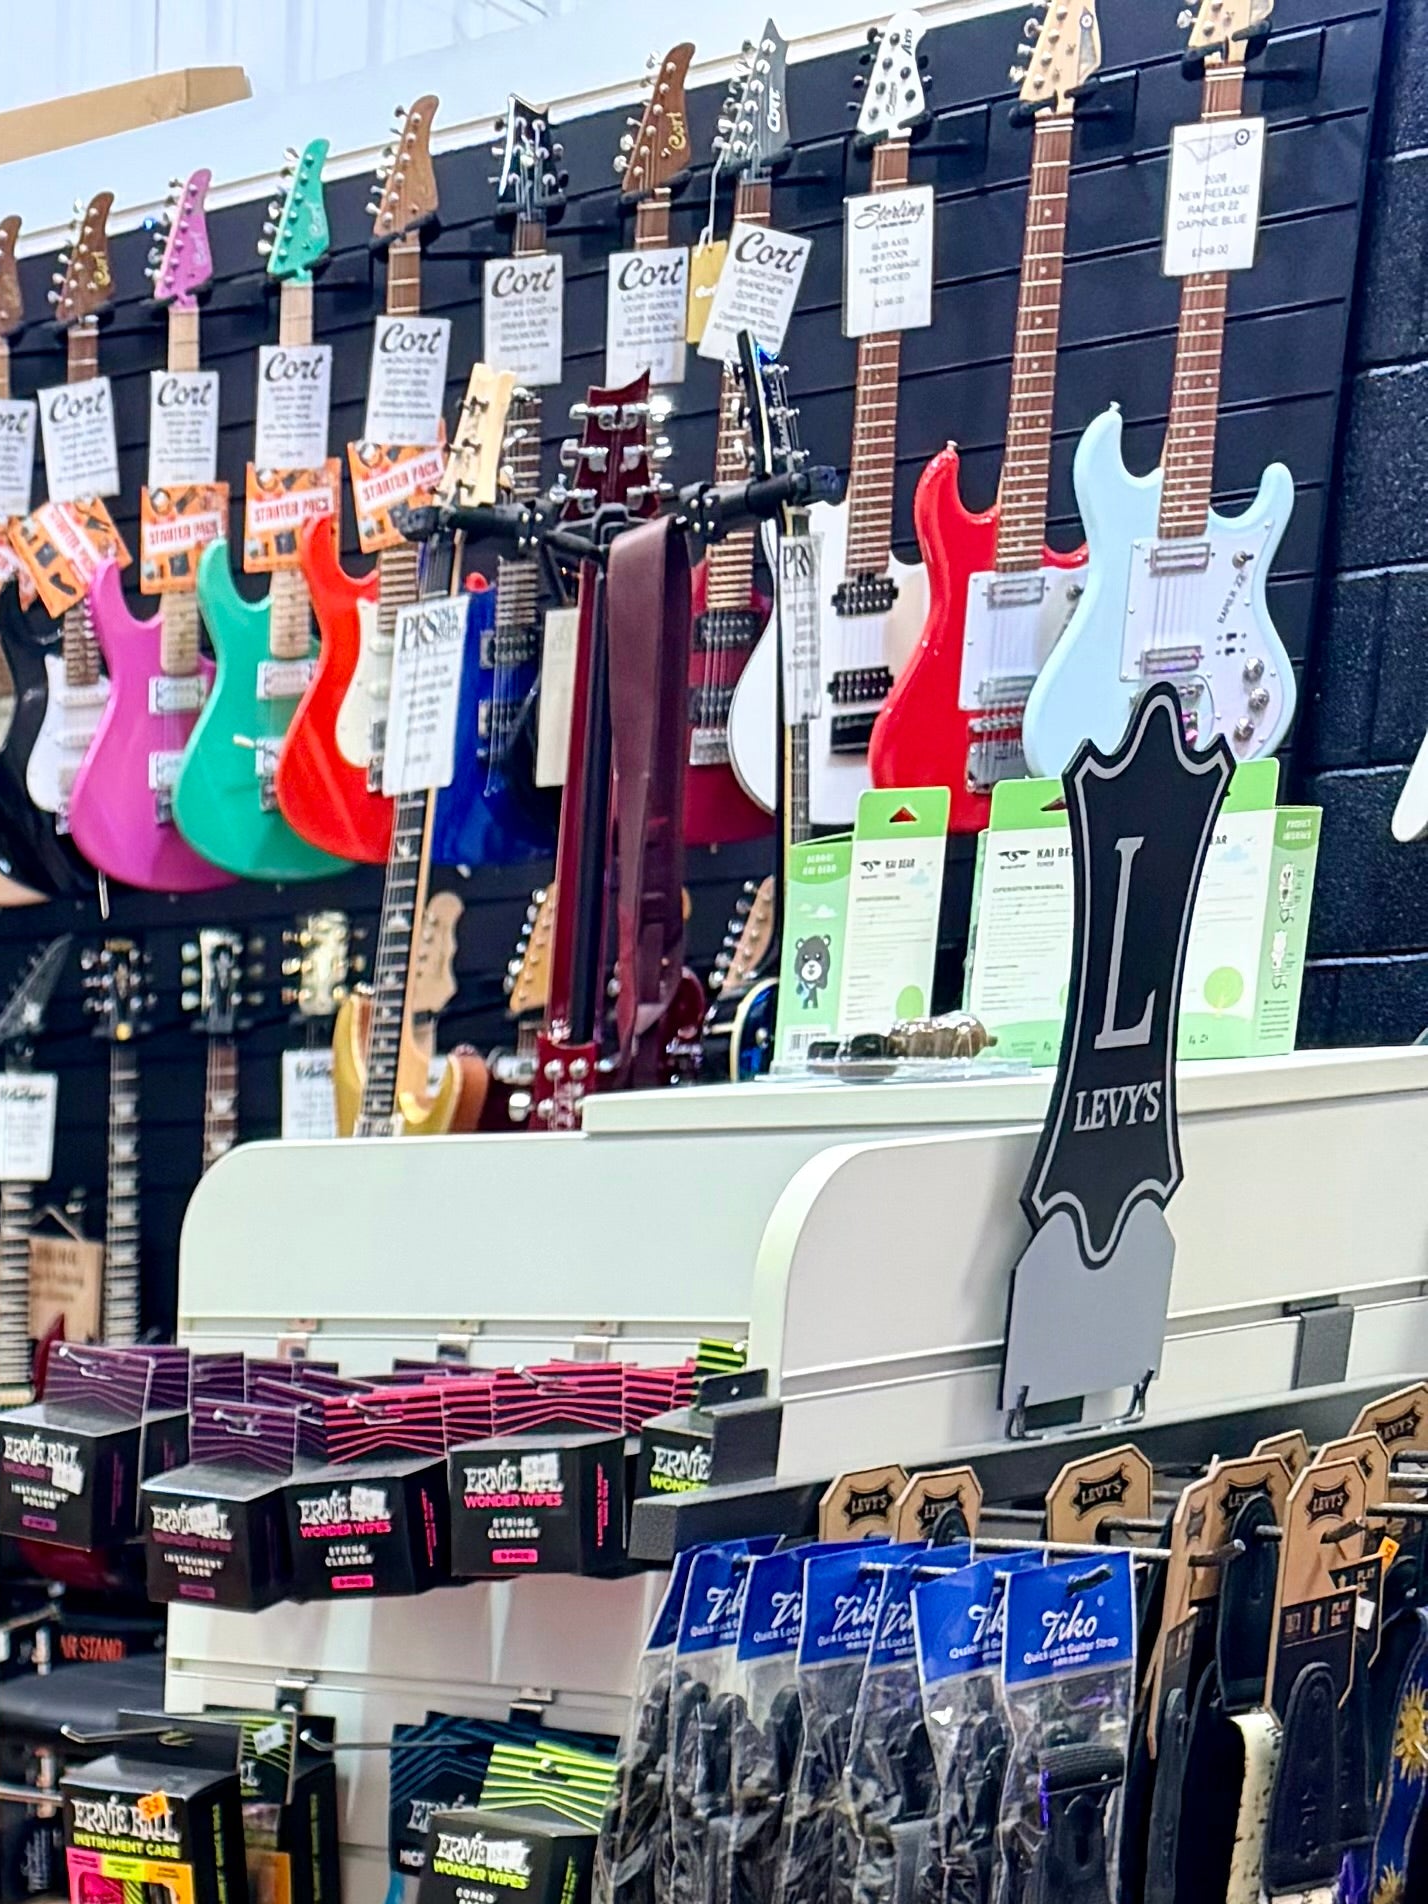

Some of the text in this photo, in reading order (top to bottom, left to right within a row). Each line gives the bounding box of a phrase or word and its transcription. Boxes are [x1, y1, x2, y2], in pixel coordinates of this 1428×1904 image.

[854, 201, 926, 231] Sterling
[734, 231, 805, 273] Cort
[491, 262, 557, 298] Cort
[618, 256, 684, 291] Cort
[379, 321, 443, 355] Cort
[265, 351, 325, 382] Cort
[50, 388, 106, 424] Cort
[157, 377, 213, 408] Cort
[362, 459, 440, 501] STARTER PACK
[1036, 847, 1055, 860] KAI
[1095, 836, 1157, 1050] L
[1073, 1079, 1164, 1134] LEVY'S
[463, 1458, 518, 1494] ERNIE
[651, 1443, 713, 1482] ERNIE
[297, 1488, 347, 1526] ERNIE
[463, 1492, 563, 1509] WONDER WIPES
[851, 1495, 889, 1514] LEVY'S
[1080, 1482, 1123, 1505] LEVY'S
[1312, 1491, 1345, 1512] LEVY'S
[300, 1520, 392, 1539] WONDER WIPES
[487, 1526, 541, 1540] CLEANER
[492, 1516, 534, 1528] STRING
[1041, 1598, 1098, 1649] Tiko
[79, 1634, 126, 1663] STAND
[71, 1792, 131, 1838] ERNIE
[73, 1831, 181, 1859] INSTRUMENT CARE
[433, 1858, 488, 1881] WONDER
[487, 1868, 531, 1890] WIPES
